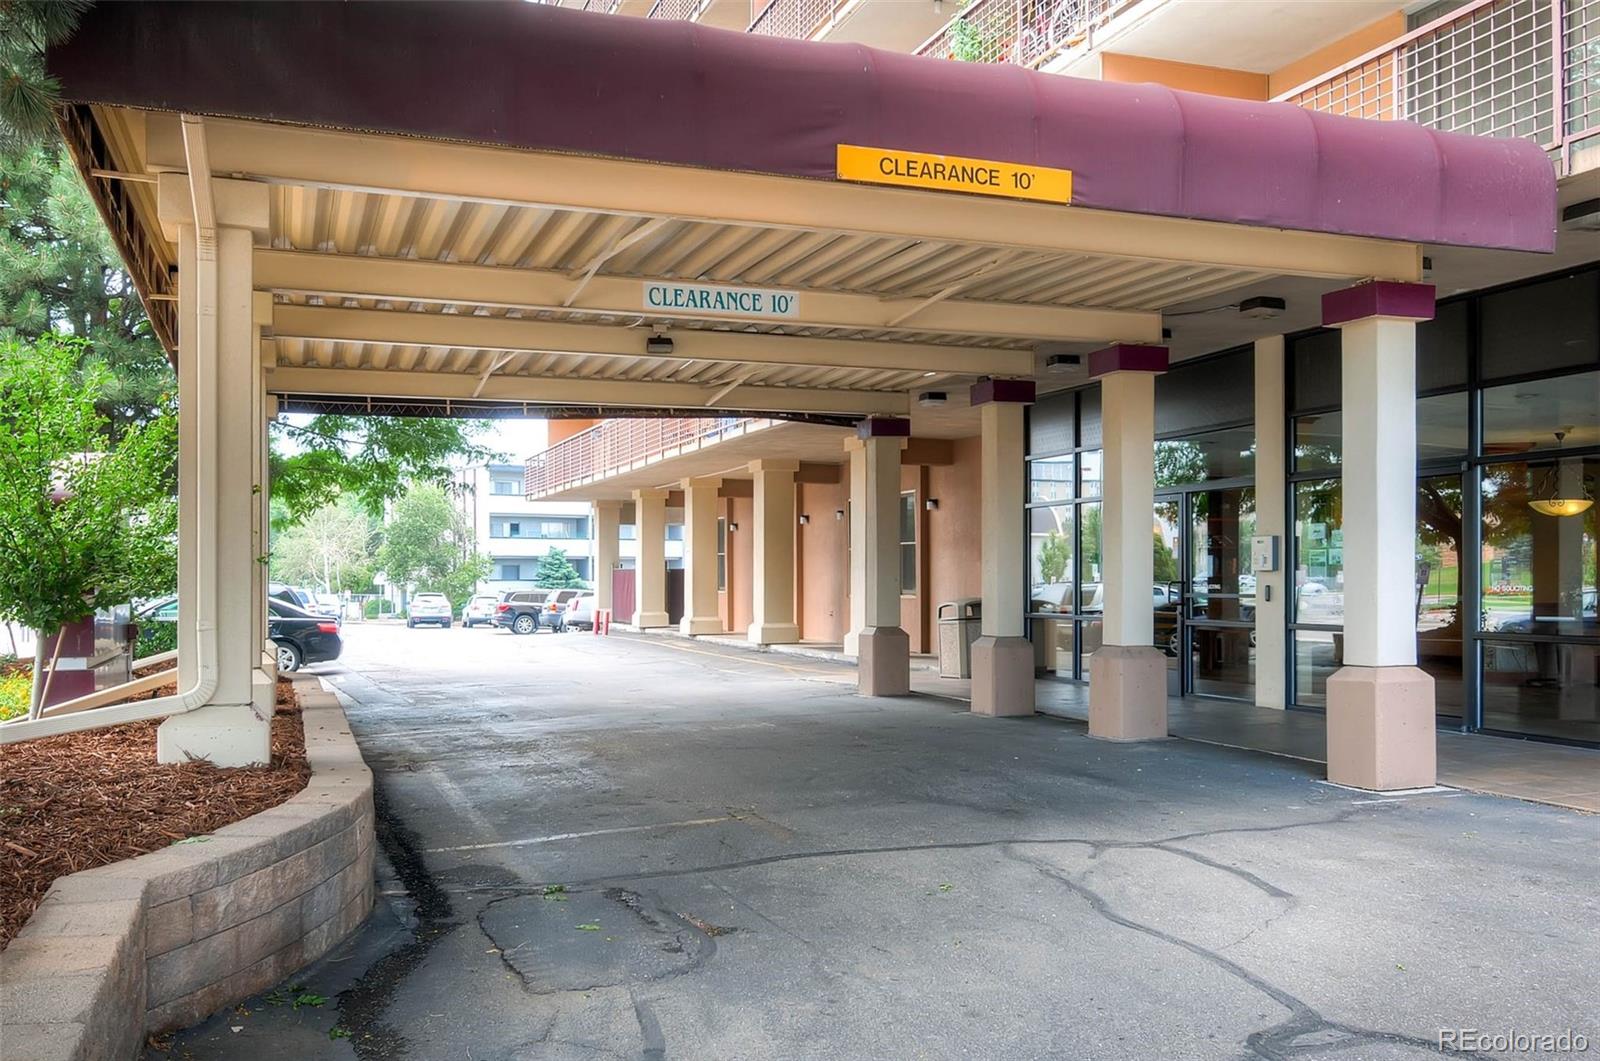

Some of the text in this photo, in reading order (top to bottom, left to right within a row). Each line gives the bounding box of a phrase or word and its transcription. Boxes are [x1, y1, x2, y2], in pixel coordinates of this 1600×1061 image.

[879, 157, 1035, 190] CLEARANCE 10'
[649, 286, 794, 313] CLEARANCE 10'
